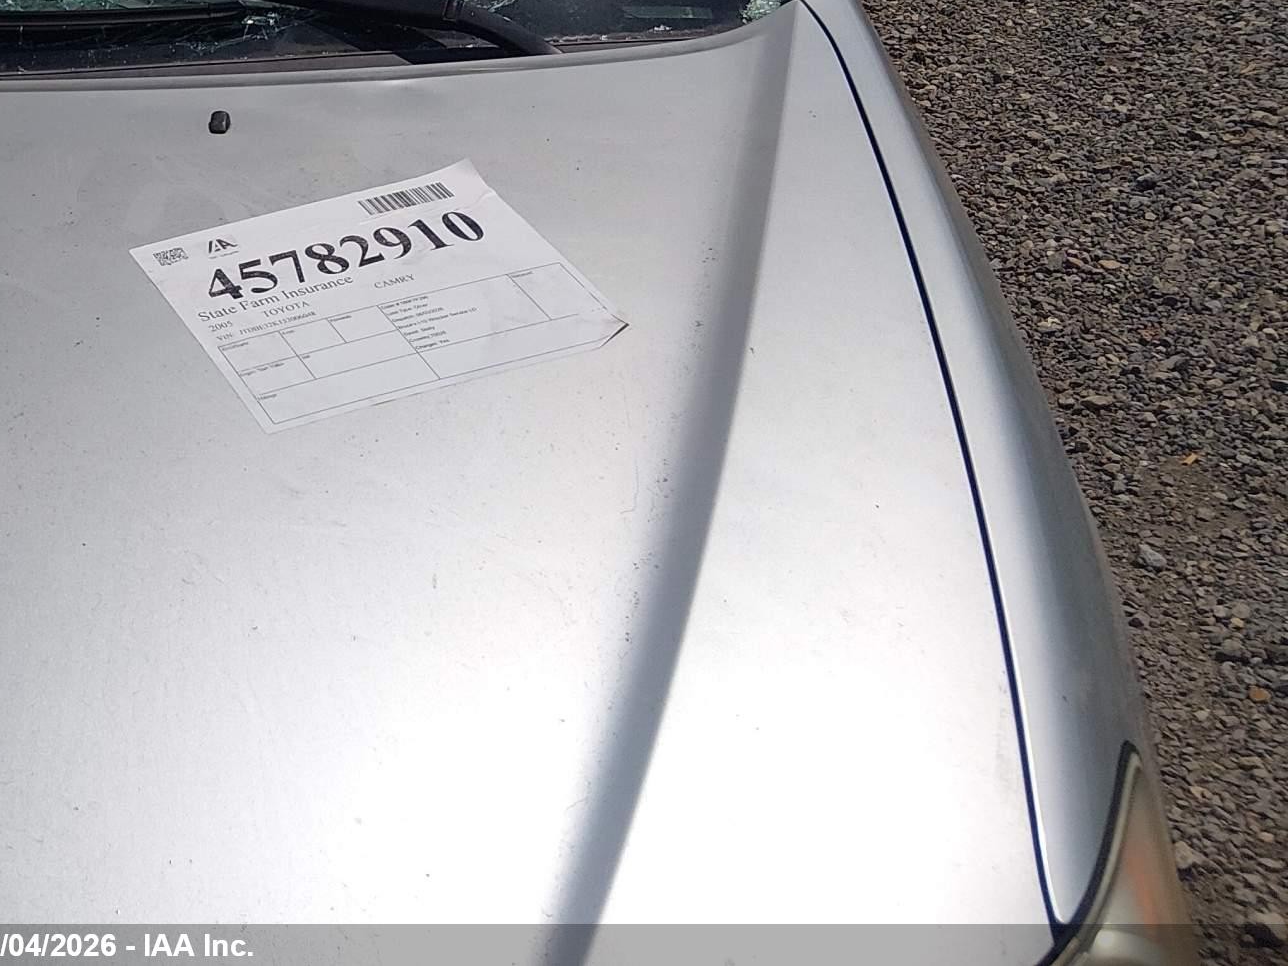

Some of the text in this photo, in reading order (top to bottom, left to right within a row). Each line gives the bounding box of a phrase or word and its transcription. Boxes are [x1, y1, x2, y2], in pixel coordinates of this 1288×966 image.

[208, 211, 484, 300] 45782910
[198, 274, 353, 322] State Farm Insurance
[208, 273, 415, 332] 2005 TOYOTA CAMRY
